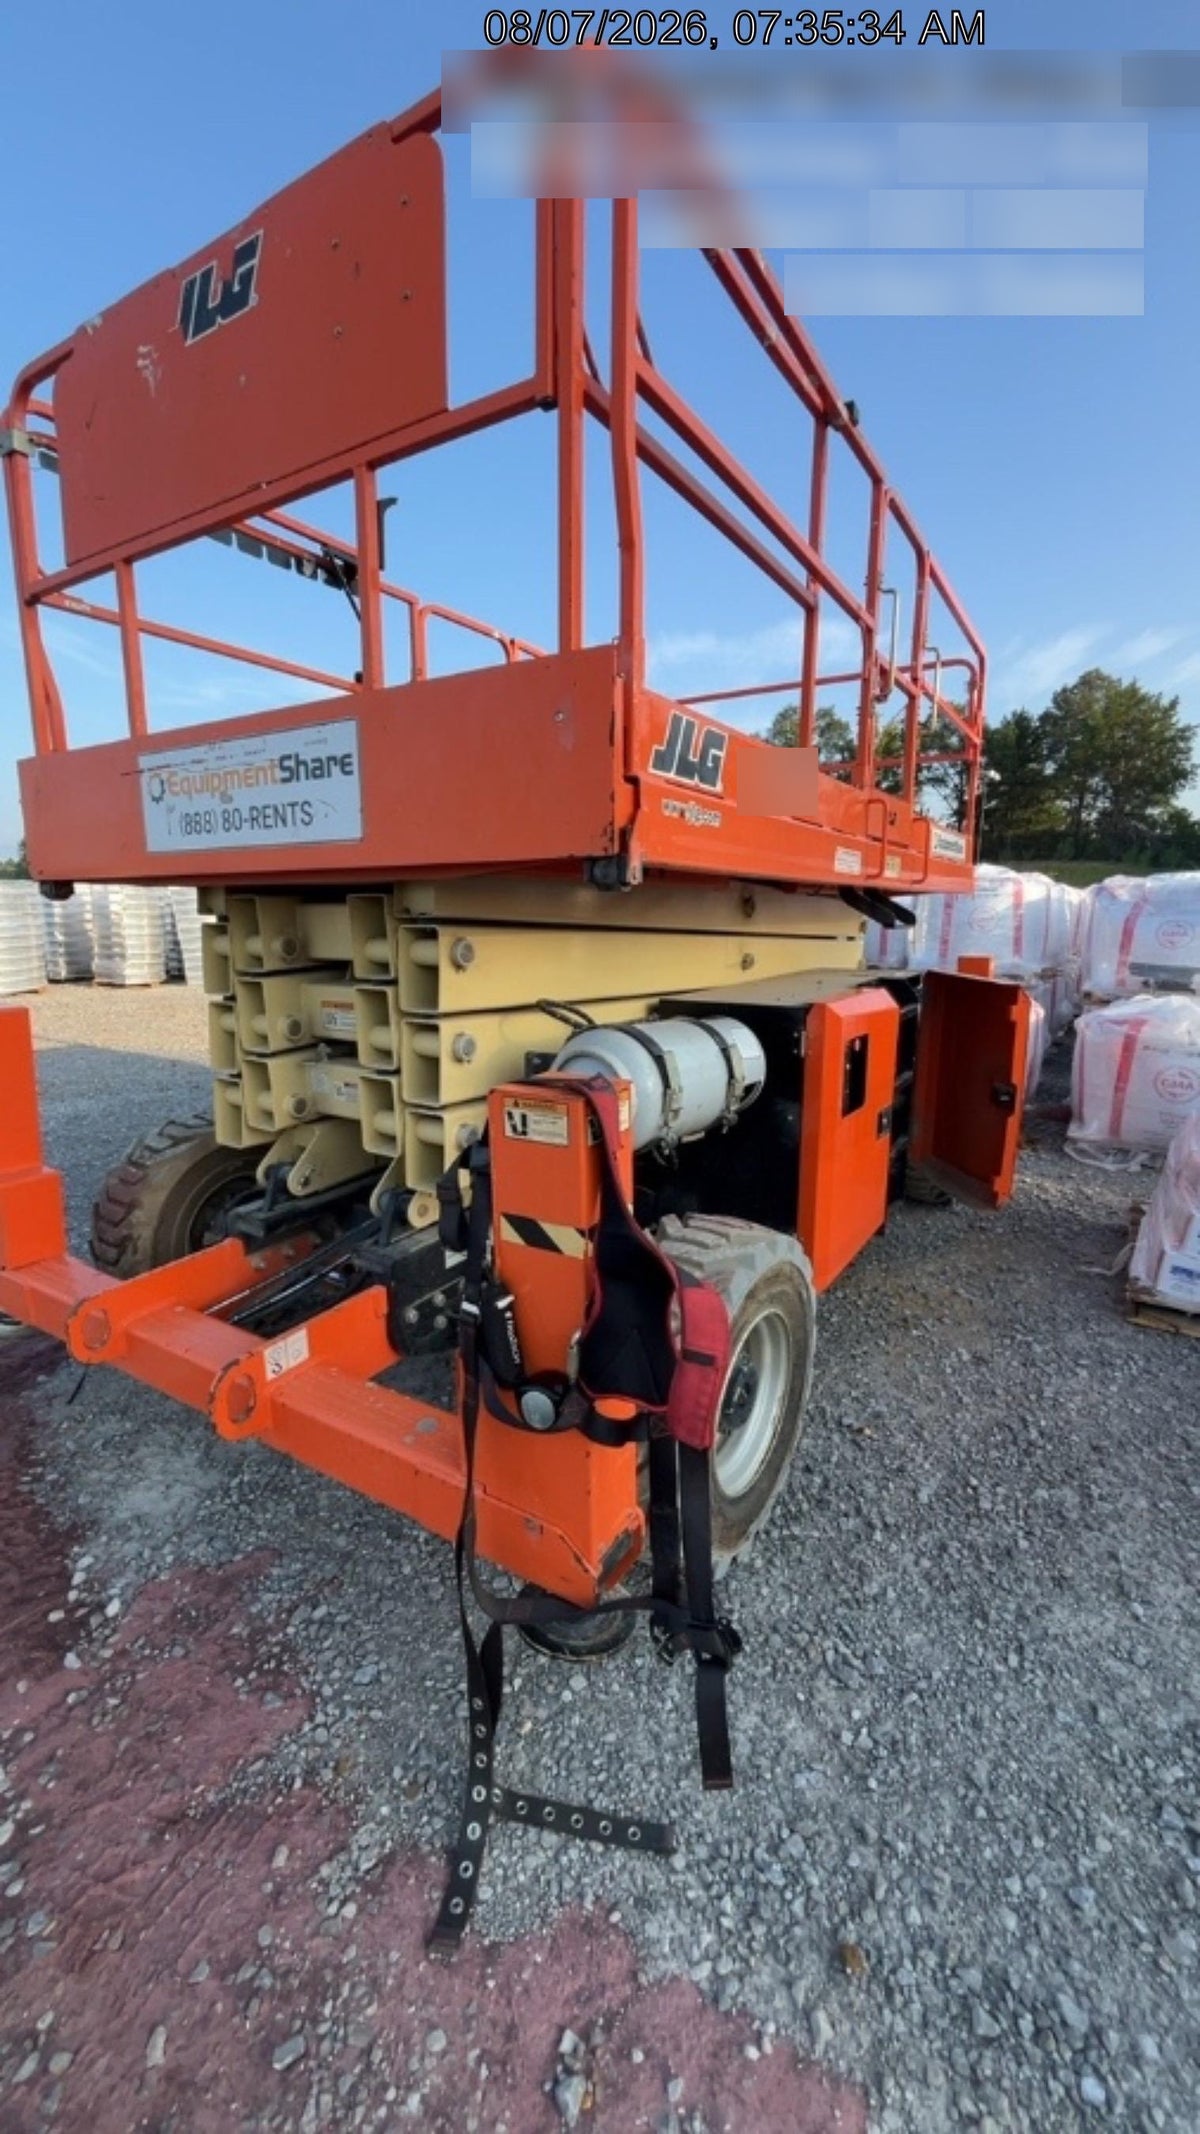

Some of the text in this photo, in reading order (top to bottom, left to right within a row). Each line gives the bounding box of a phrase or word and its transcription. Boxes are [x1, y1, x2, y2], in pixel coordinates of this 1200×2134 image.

[647, 709, 727, 793] JLG
[167, 753, 354, 800] EquipmentShare
[180, 801, 314, 838] (888) 80-RENTS
